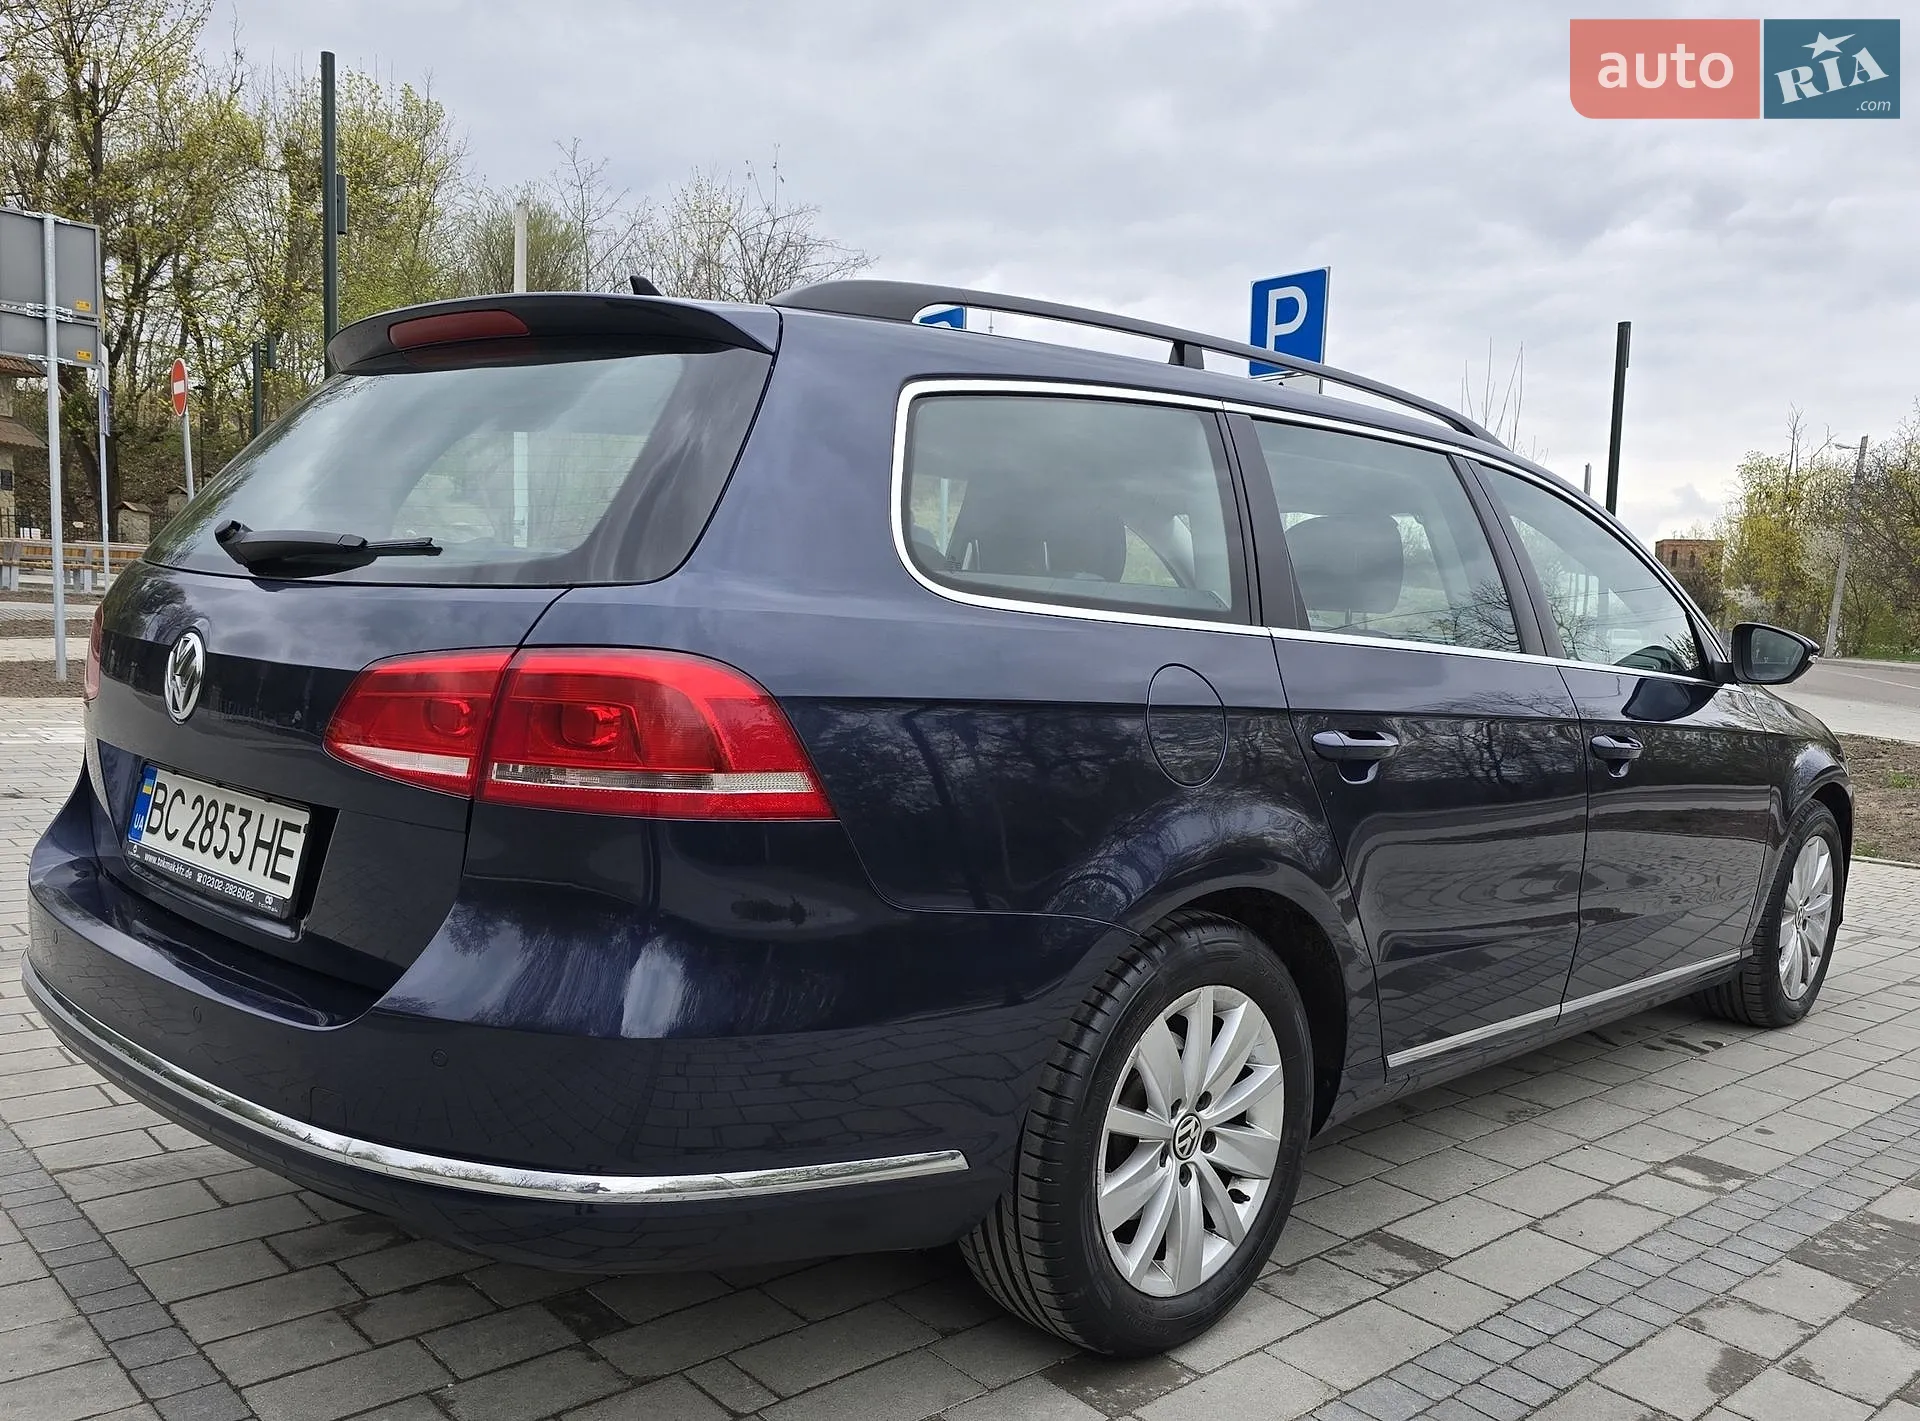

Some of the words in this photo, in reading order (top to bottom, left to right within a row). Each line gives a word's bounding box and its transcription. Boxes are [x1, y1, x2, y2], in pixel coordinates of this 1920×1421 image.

[1266, 286, 1308, 350] P
[133, 814, 145, 832] UA
[145, 781, 186, 841] BC
[182, 795, 252, 865] 2853
[248, 813, 302, 885] HE
[144, 853, 192, 879] www.tokmak-kfz.de
